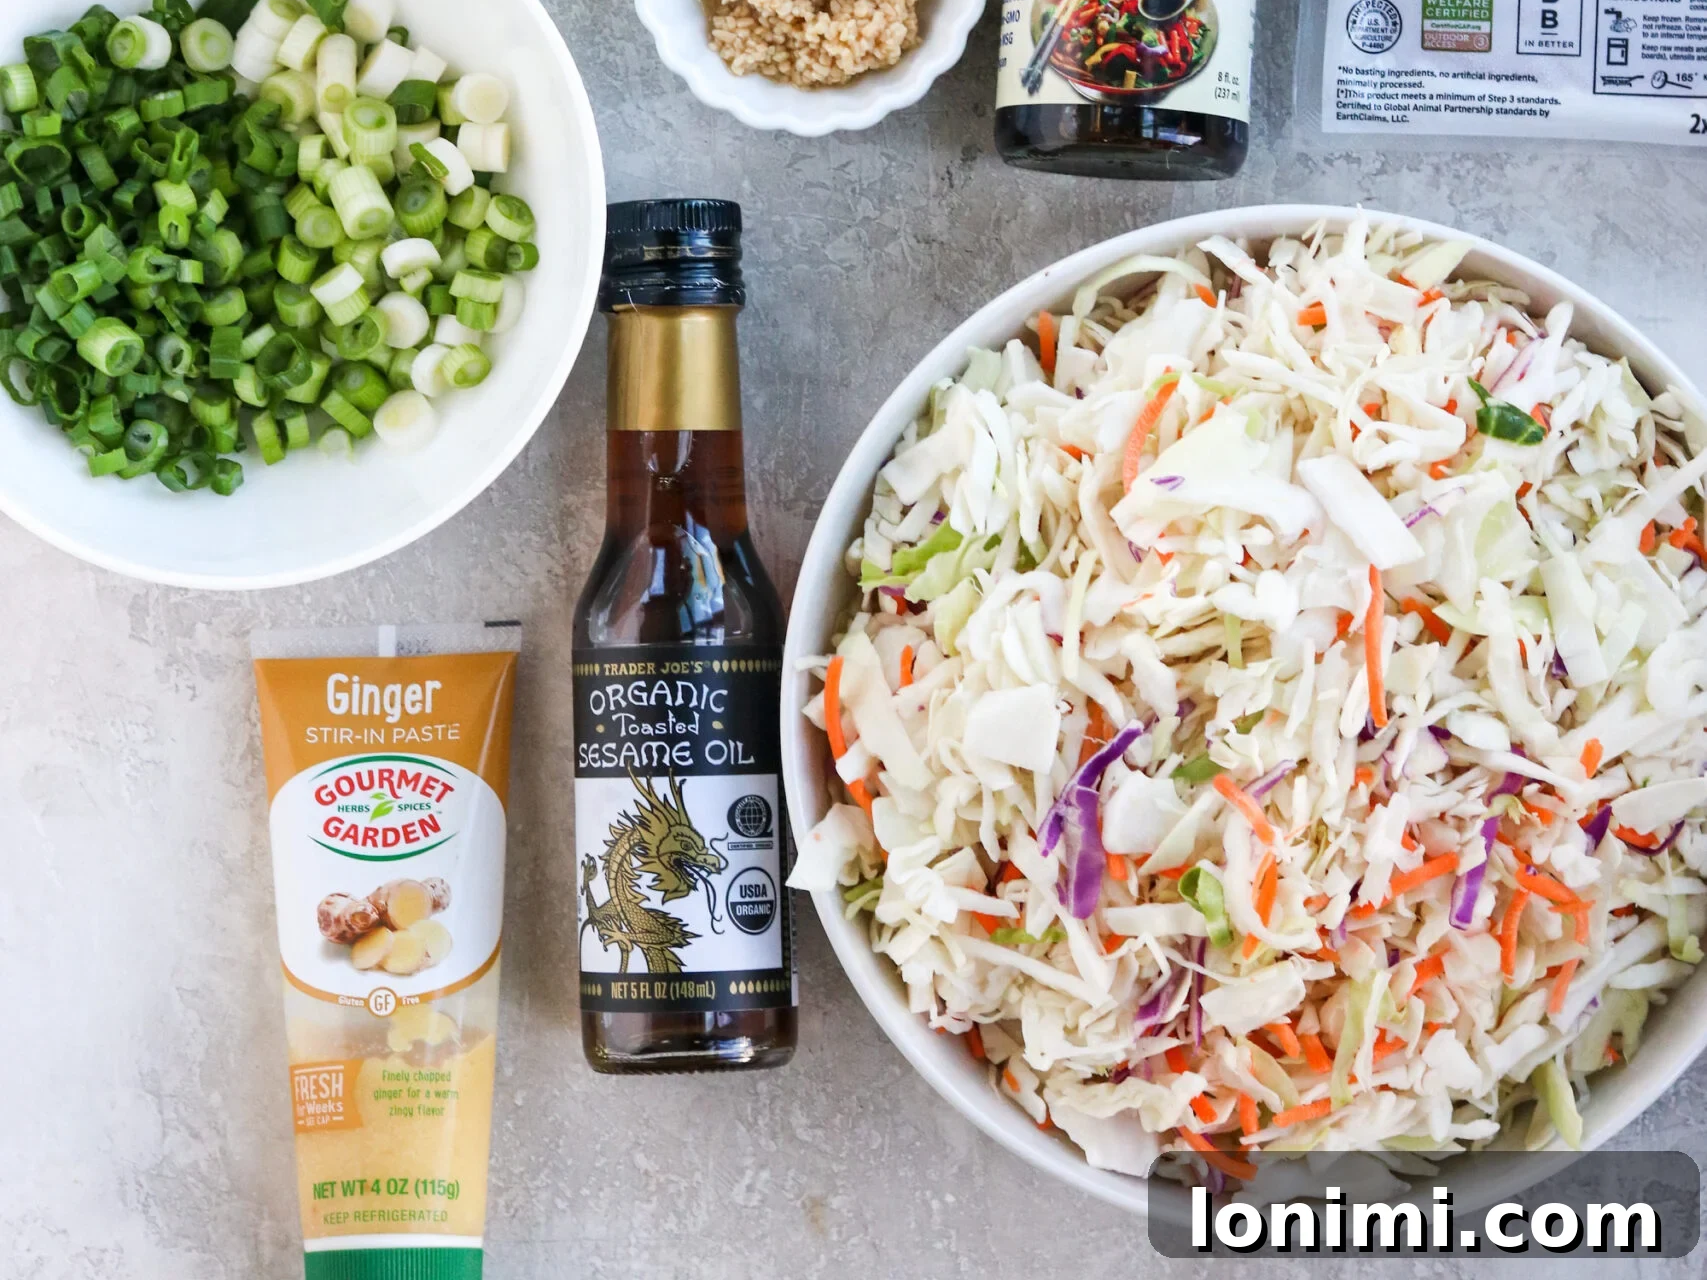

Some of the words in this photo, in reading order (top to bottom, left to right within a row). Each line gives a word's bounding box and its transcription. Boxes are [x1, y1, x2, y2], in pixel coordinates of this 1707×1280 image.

[1352, 0, 1398, 20] INSPECTED
[1425, 7, 1490, 19] CERTIFIED
[1540, 8, 1559, 29] B
[1423, 32, 1470, 42] OUTDOOR
[1423, 40, 1457, 49] ACCESS
[1524, 40, 1535, 48] IN
[1537, 40, 1575, 49] BETTER
[1355, 67, 1386, 78] basting
[1387, 68, 1438, 79] ingredients,
[1439, 71, 1450, 79] no
[1451, 70, 1486, 80] artificial
[1487, 72, 1539, 84] ingredients,
[1337, 79, 1379, 89] minimally
[1379, 80, 1425, 90] processed.
[1366, 91, 1399, 101] product
[1400, 92, 1427, 101] meets
[1435, 92, 1476, 102] minimum
[1477, 93, 1486, 102] of
[1487, 93, 1508, 105] Step
[1516, 95, 1562, 106] standards.
[1336, 101, 1372, 111] Certified
[1373, 102, 1382, 111] to
[1383, 102, 1411, 112] Global
[1412, 103, 1442, 113] Animal
[1444, 104, 1494, 116] Partnership
[1495, 107, 1537, 117] standards
[1538, 108, 1550, 119] by
[603, 662, 656, 676] TRADER
[661, 661, 704, 675] JOE'S
[326, 672, 442, 724] Ginger
[589, 680, 729, 716] ORGANIC
[612, 709, 701, 738] Toasted
[305, 727, 386, 745] STIR-IN
[392, 722, 461, 745] PASTE
[578, 740, 694, 769] SESAME
[704, 739, 756, 766] OIL
[314, 768, 455, 807] GOURMET
[337, 804, 370, 814] HERBS
[397, 802, 432, 813] SPICES
[322, 812, 443, 849] GARDEN
[740, 883, 768, 899] USDA
[736, 903, 772, 916] ORGANIC
[611, 982, 629, 1000] NET
[631, 982, 640, 1000] 5
[641, 982, 652, 1000] FL
[654, 981, 668, 1000] OZ
[338, 995, 365, 1008] Gluten
[374, 994, 392, 1012] GF
[402, 995, 420, 1007] Free
[382, 1069, 410, 1083] Finely
[413, 1069, 453, 1083] chopped
[294, 1072, 345, 1102] FRESH
[373, 1088, 402, 1101] ginger
[407, 1087, 421, 1099] for
[434, 1090, 460, 1099] warm
[305, 1100, 345, 1115] Weeks
[389, 1105, 414, 1117] zingy
[418, 1104, 445, 1117] flavor
[313, 1180, 337, 1201] NET
[341, 1179, 367, 1197] WT
[370, 1178, 381, 1195] 4
[386, 1178, 409, 1195] OZ
[414, 1178, 460, 1201] (115g)
[323, 1211, 350, 1226] KEEP
[353, 1209, 449, 1224] REFRIGERATED
